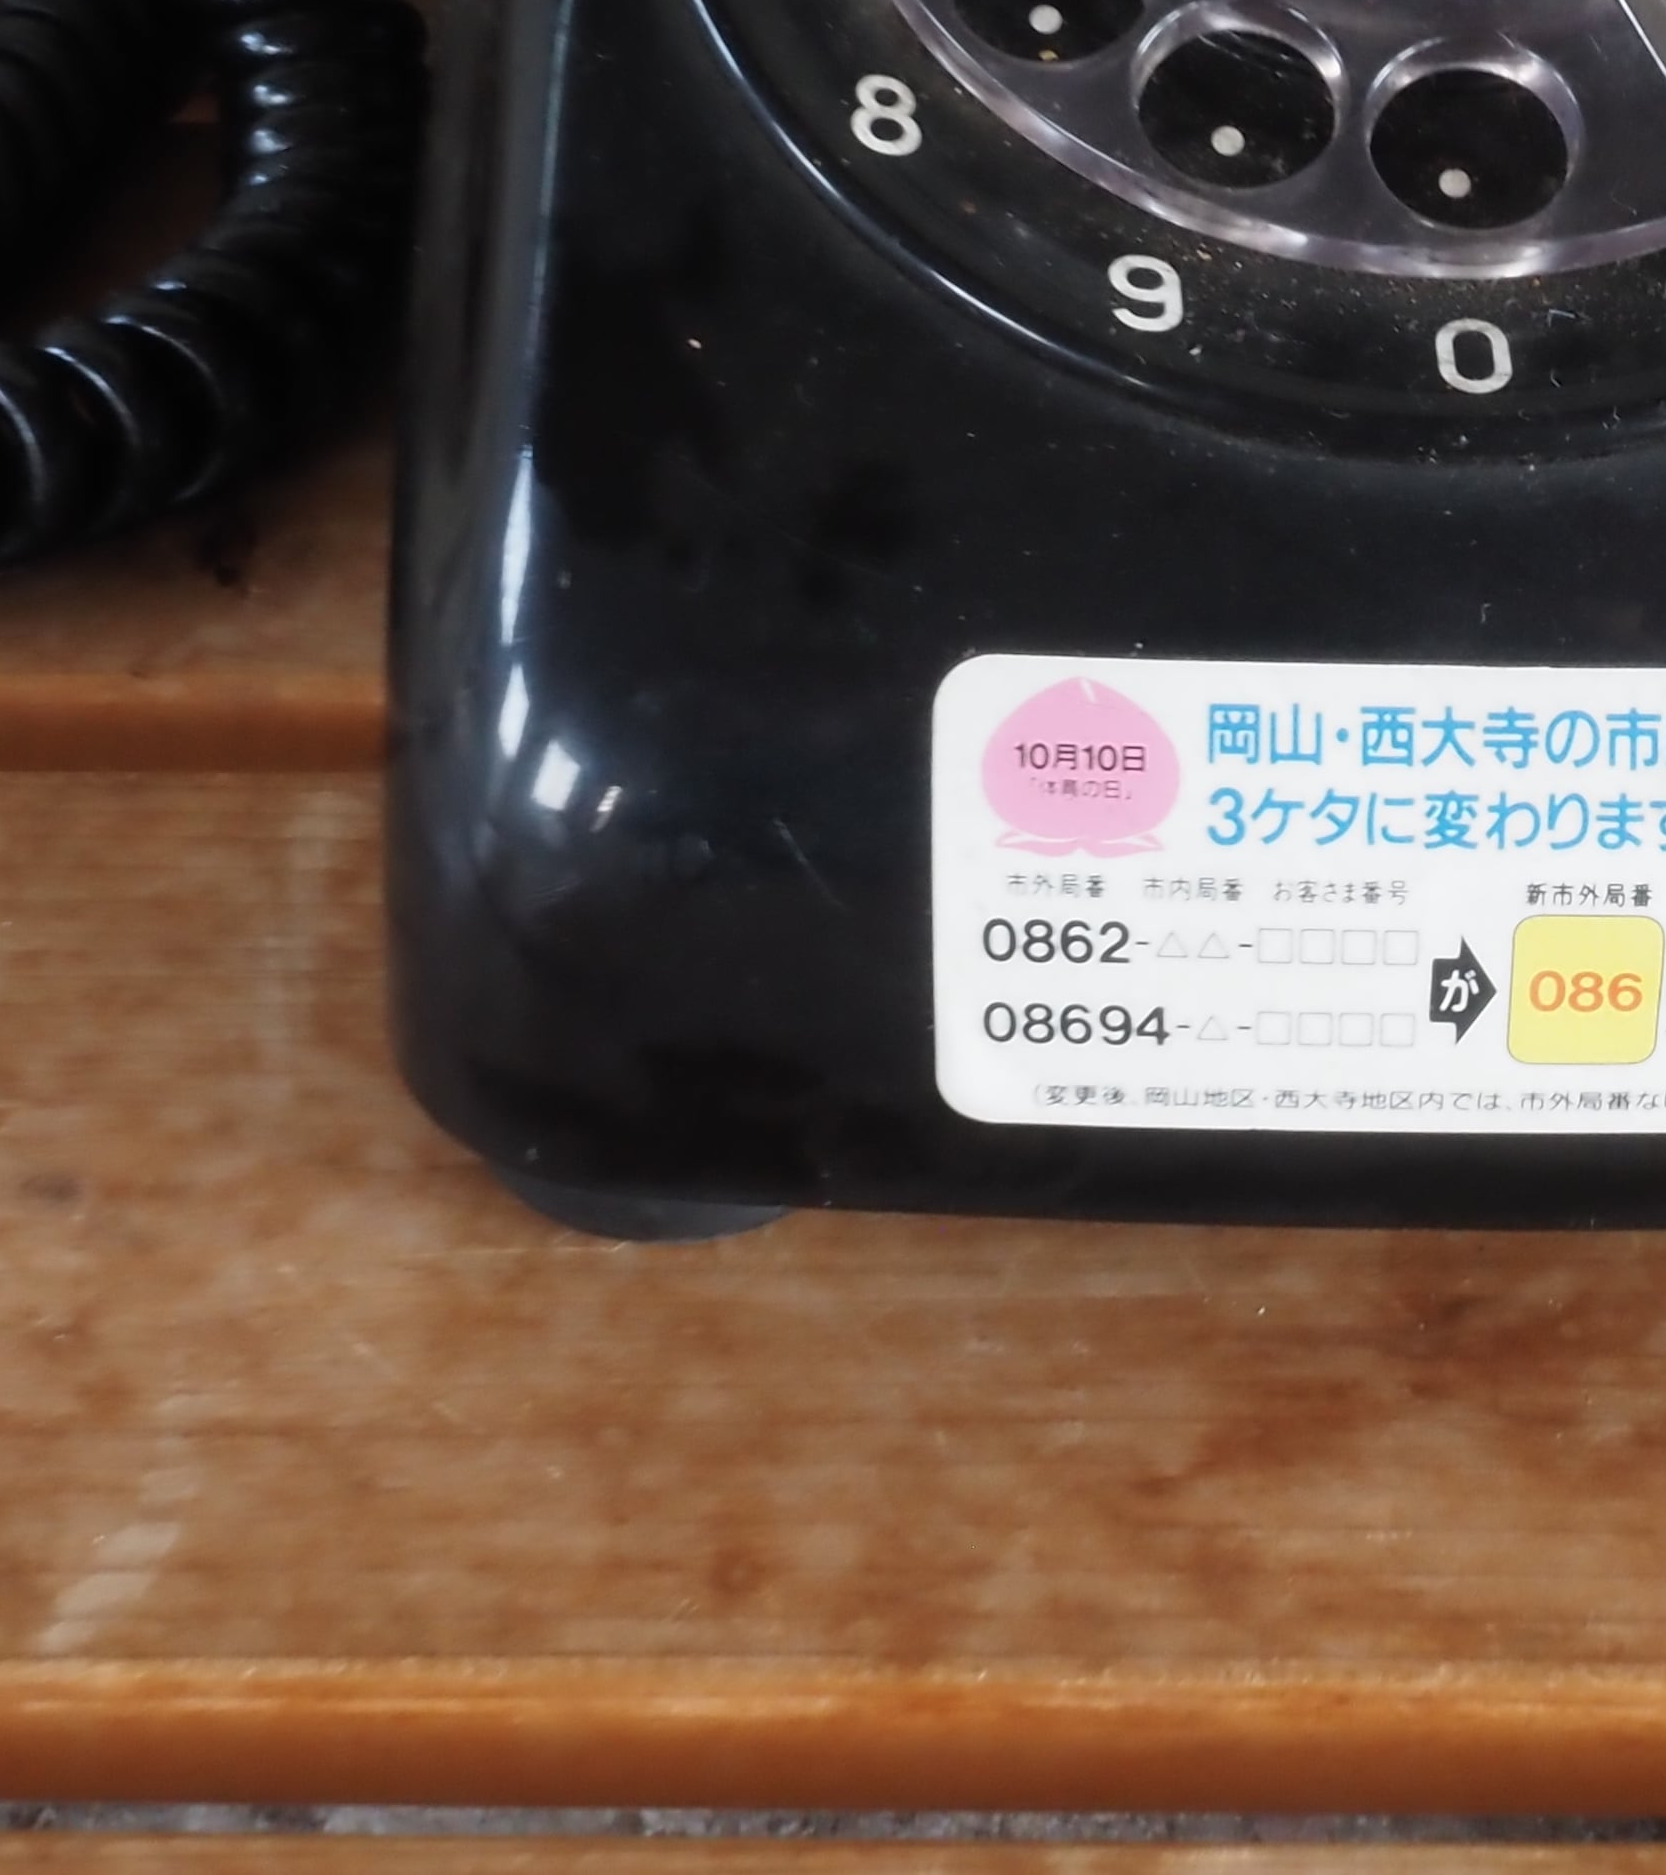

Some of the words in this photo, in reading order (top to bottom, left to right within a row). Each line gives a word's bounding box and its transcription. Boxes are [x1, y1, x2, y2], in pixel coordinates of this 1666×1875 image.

[850, 73, 923, 157] 8
[1106, 253, 1185, 333] 9
[1434, 317, 1514, 395] 0
[1014, 741, 1147, 773] 10月10日
[1143, 877, 1244, 903] 市内局番
[1525, 882, 1654, 908] 新市外局番
[1438, 968, 1481, 1014] が
[1529, 969, 1644, 1013] 086
